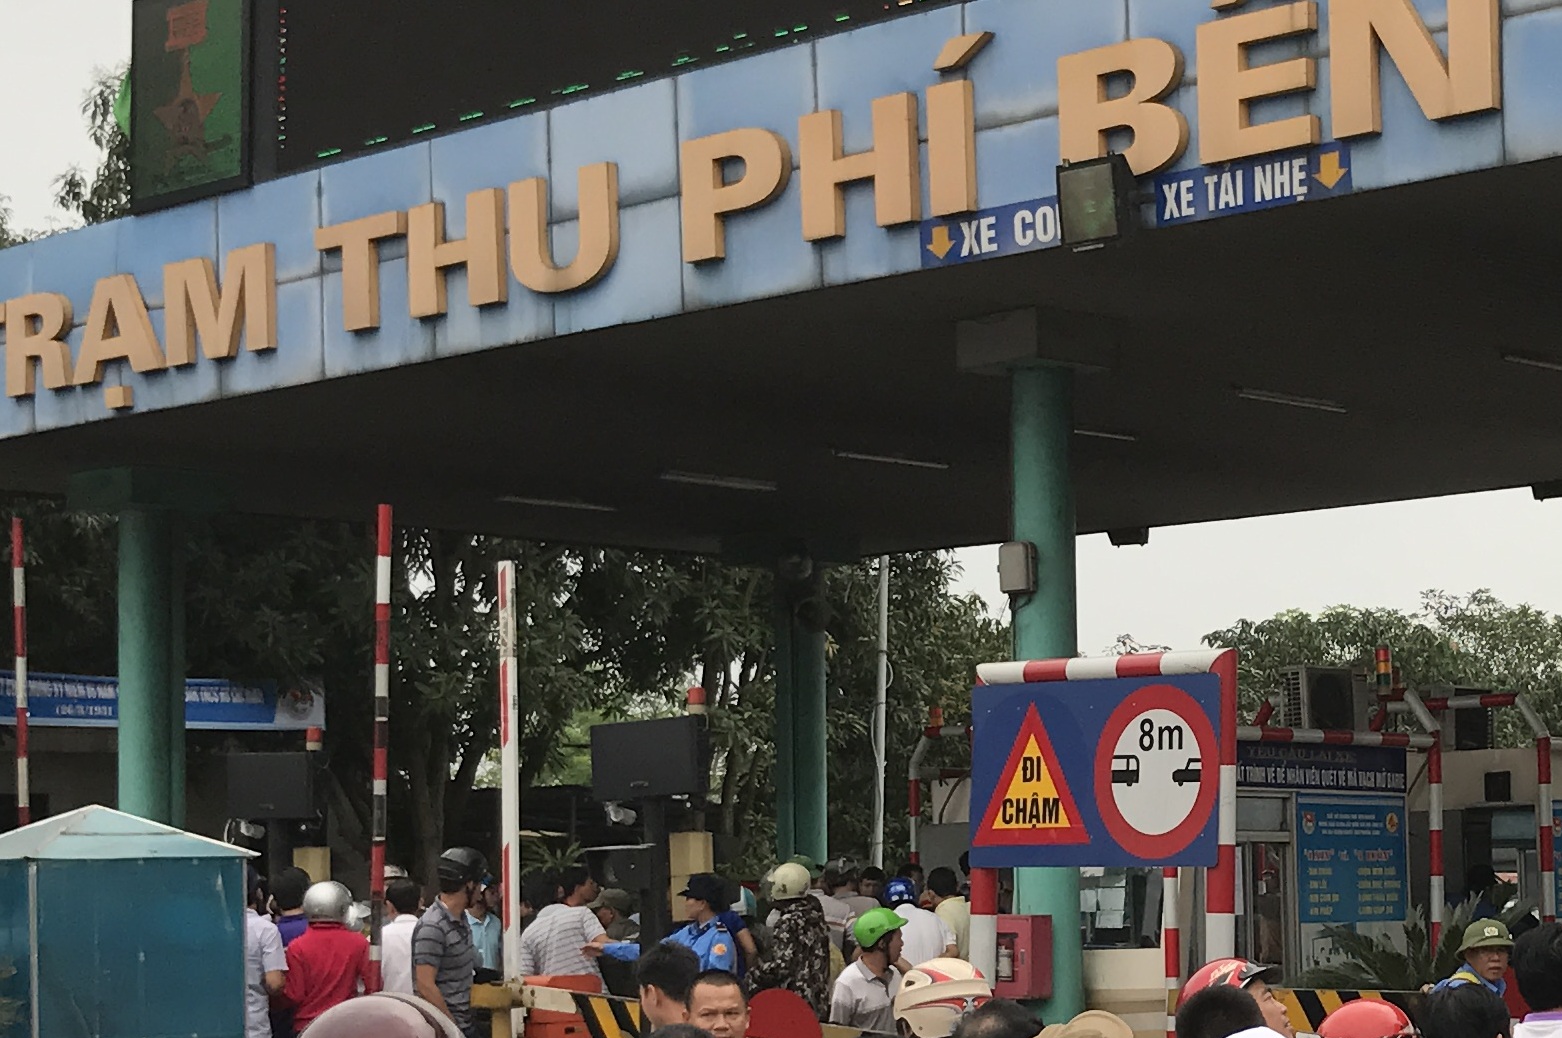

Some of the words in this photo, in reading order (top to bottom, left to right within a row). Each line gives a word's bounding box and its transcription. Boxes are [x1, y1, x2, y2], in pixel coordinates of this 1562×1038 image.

[1162, 179, 1195, 221] XE
[1254, 157, 1308, 203] NHẸ
[0, 242, 276, 409] RẠM
[315, 161, 619, 332] THU
[681, 31, 994, 264] PHÍ
[959, 216, 998, 258] XE
[1139, 718, 1183, 751] 8m
[1022, 756, 1041, 782] ĐI
[1002, 792, 1060, 829] CHẬM
